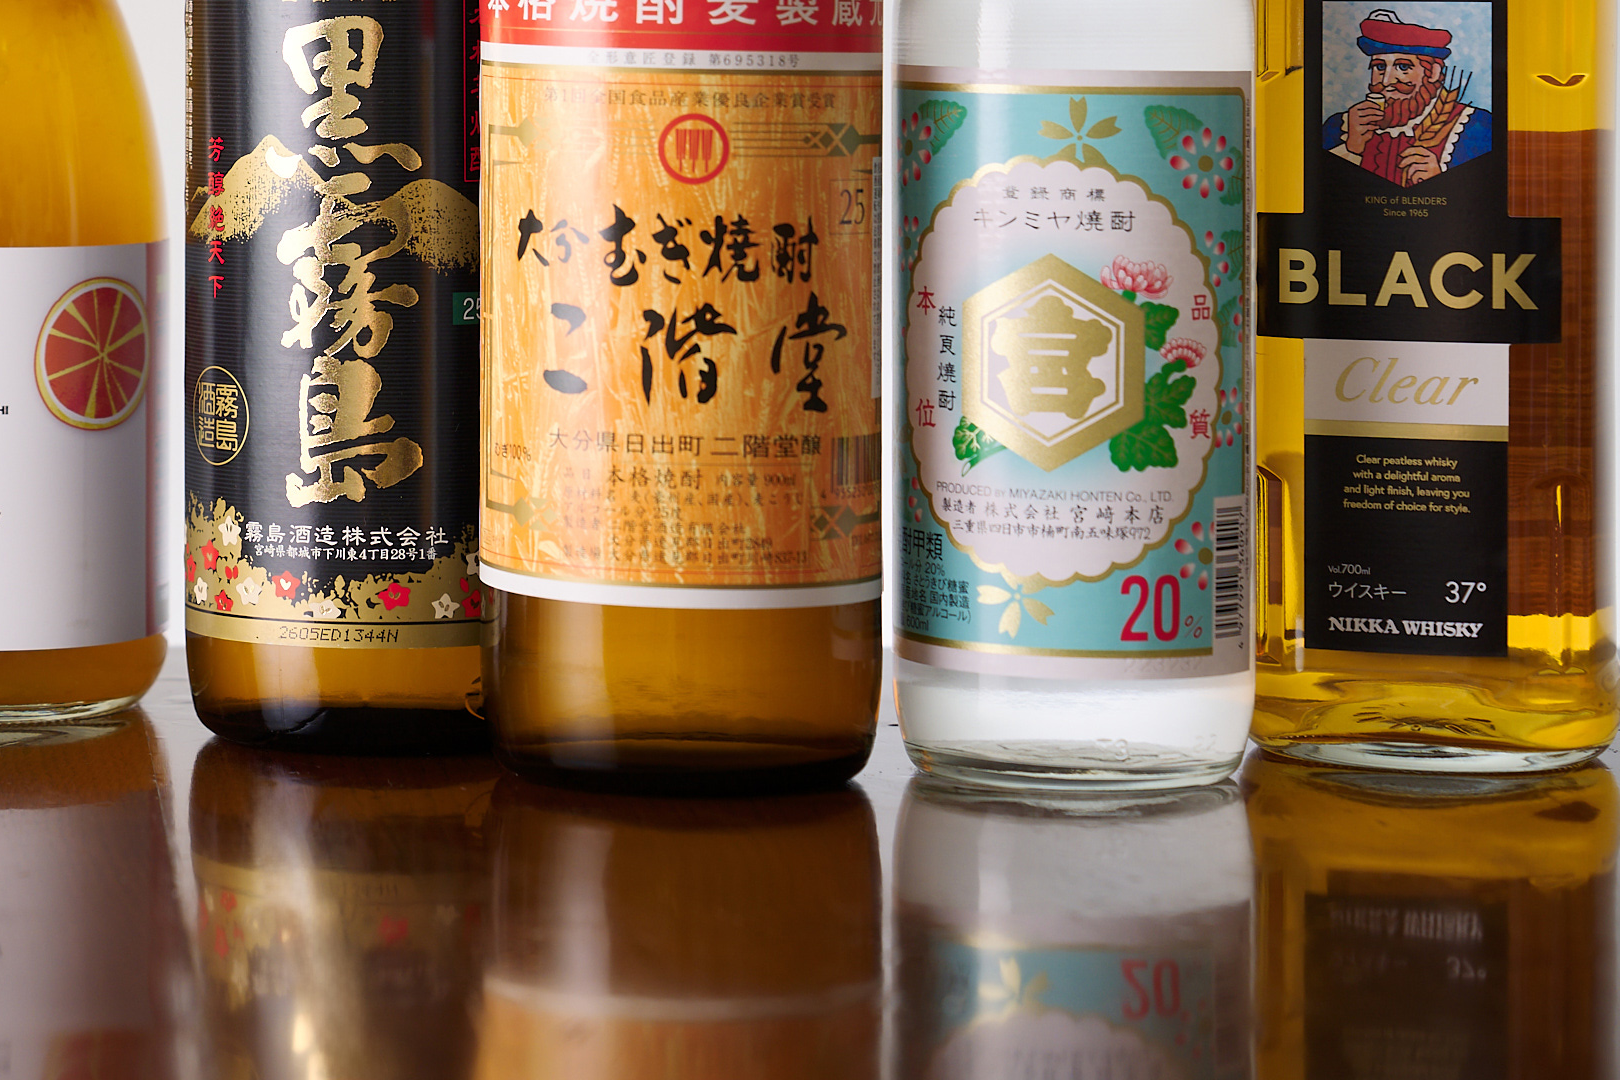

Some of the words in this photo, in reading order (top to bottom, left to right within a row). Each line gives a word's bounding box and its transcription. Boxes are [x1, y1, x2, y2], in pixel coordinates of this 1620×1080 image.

[839, 187, 866, 226] 25
[1365, 196, 1388, 206] KING
[1390, 196, 1400, 206] of
[1402, 196, 1447, 207] BLENDERS
[1383, 208, 1407, 218] Since
[1409, 209, 1429, 219] 1965
[277, 15, 424, 508] 黒霧島
[1279, 248, 1540, 311] BLACK
[543, 291, 848, 414] 二階堂
[1334, 356, 1480, 407] Clear
[1356, 454, 1381, 465] Clear
[1383, 455, 1423, 468] peatless
[1425, 456, 1458, 469] whisky
[608, 464, 702, 491] 本格焼酎
[1352, 469, 1374, 480] with
[1376, 472, 1382, 480] a
[1384, 469, 1429, 483] delightful
[1431, 474, 1461, 483] aroma
[936, 480, 992, 497] PRODUCED
[1009, 488, 1068, 501] MIYAZAKI
[1070, 490, 1123, 503] HONTEN
[1150, 490, 1174, 503] LTD.
[1343, 484, 1361, 494] and
[1363, 484, 1385, 498] light
[1387, 485, 1415, 498] finish,
[1416, 486, 1450, 500] leaving
[1452, 490, 1470, 500] you
[1343, 498, 1382, 510] freedom
[1383, 499, 1394, 510] of
[1396, 500, 1427, 512] choice
[1428, 501, 1443, 512] for
[1445, 502, 1471, 515] style.
[244, 522, 450, 547] 霧島酒造株式会社
[1329, 581, 1407, 601] ウイスキー
[1329, 617, 1400, 635] NIKKA
[1401, 620, 1484, 638] WHISKY
